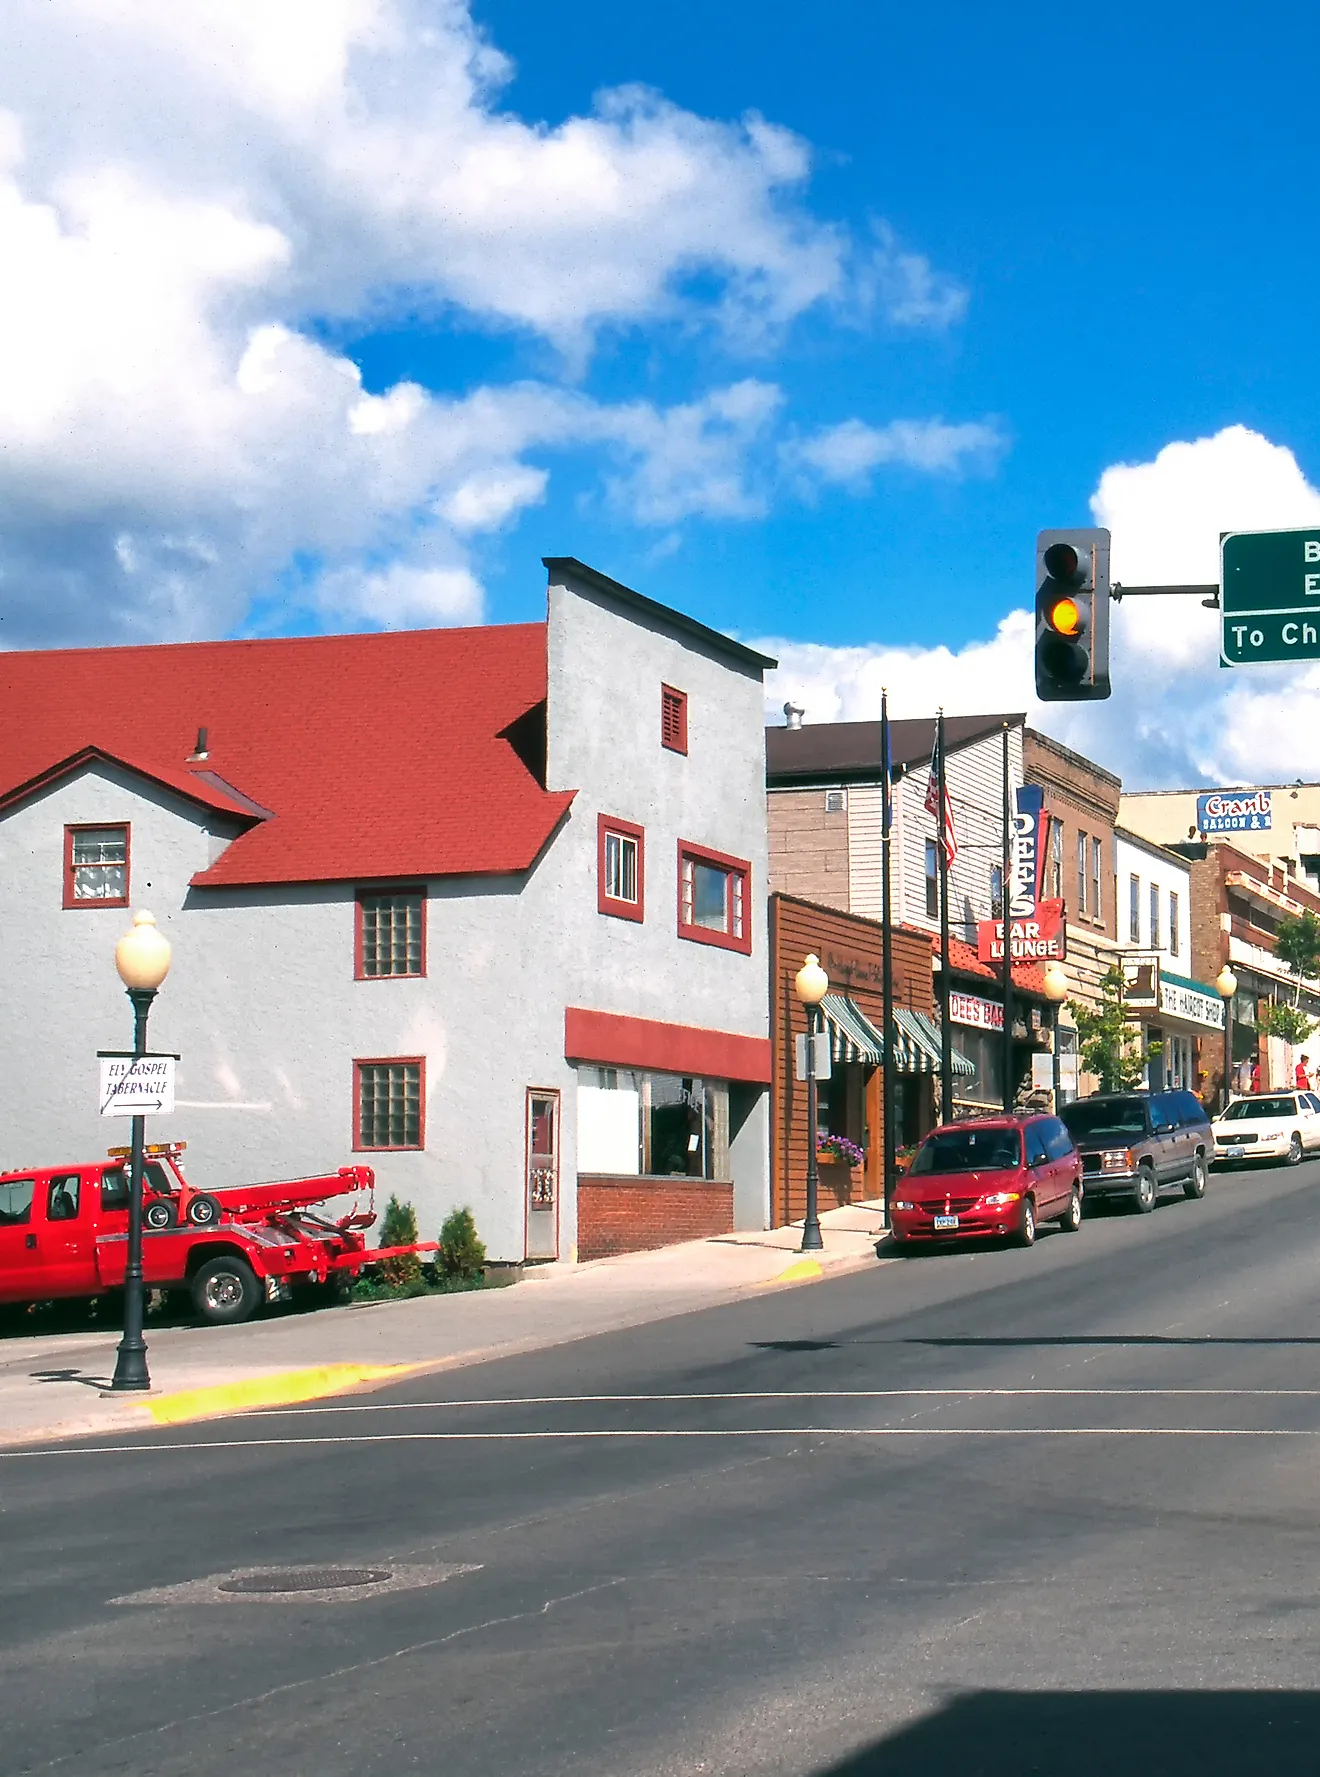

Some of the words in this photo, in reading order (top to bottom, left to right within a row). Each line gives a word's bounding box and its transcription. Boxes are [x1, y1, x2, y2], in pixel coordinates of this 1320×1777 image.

[1231, 624, 1264, 649] To
[1203, 817, 1246, 830] SALOON
[995, 922, 1041, 940] BAR
[130, 1062, 168, 1076] GOSPEL
[106, 1081, 168, 1095] TABERNACLE
